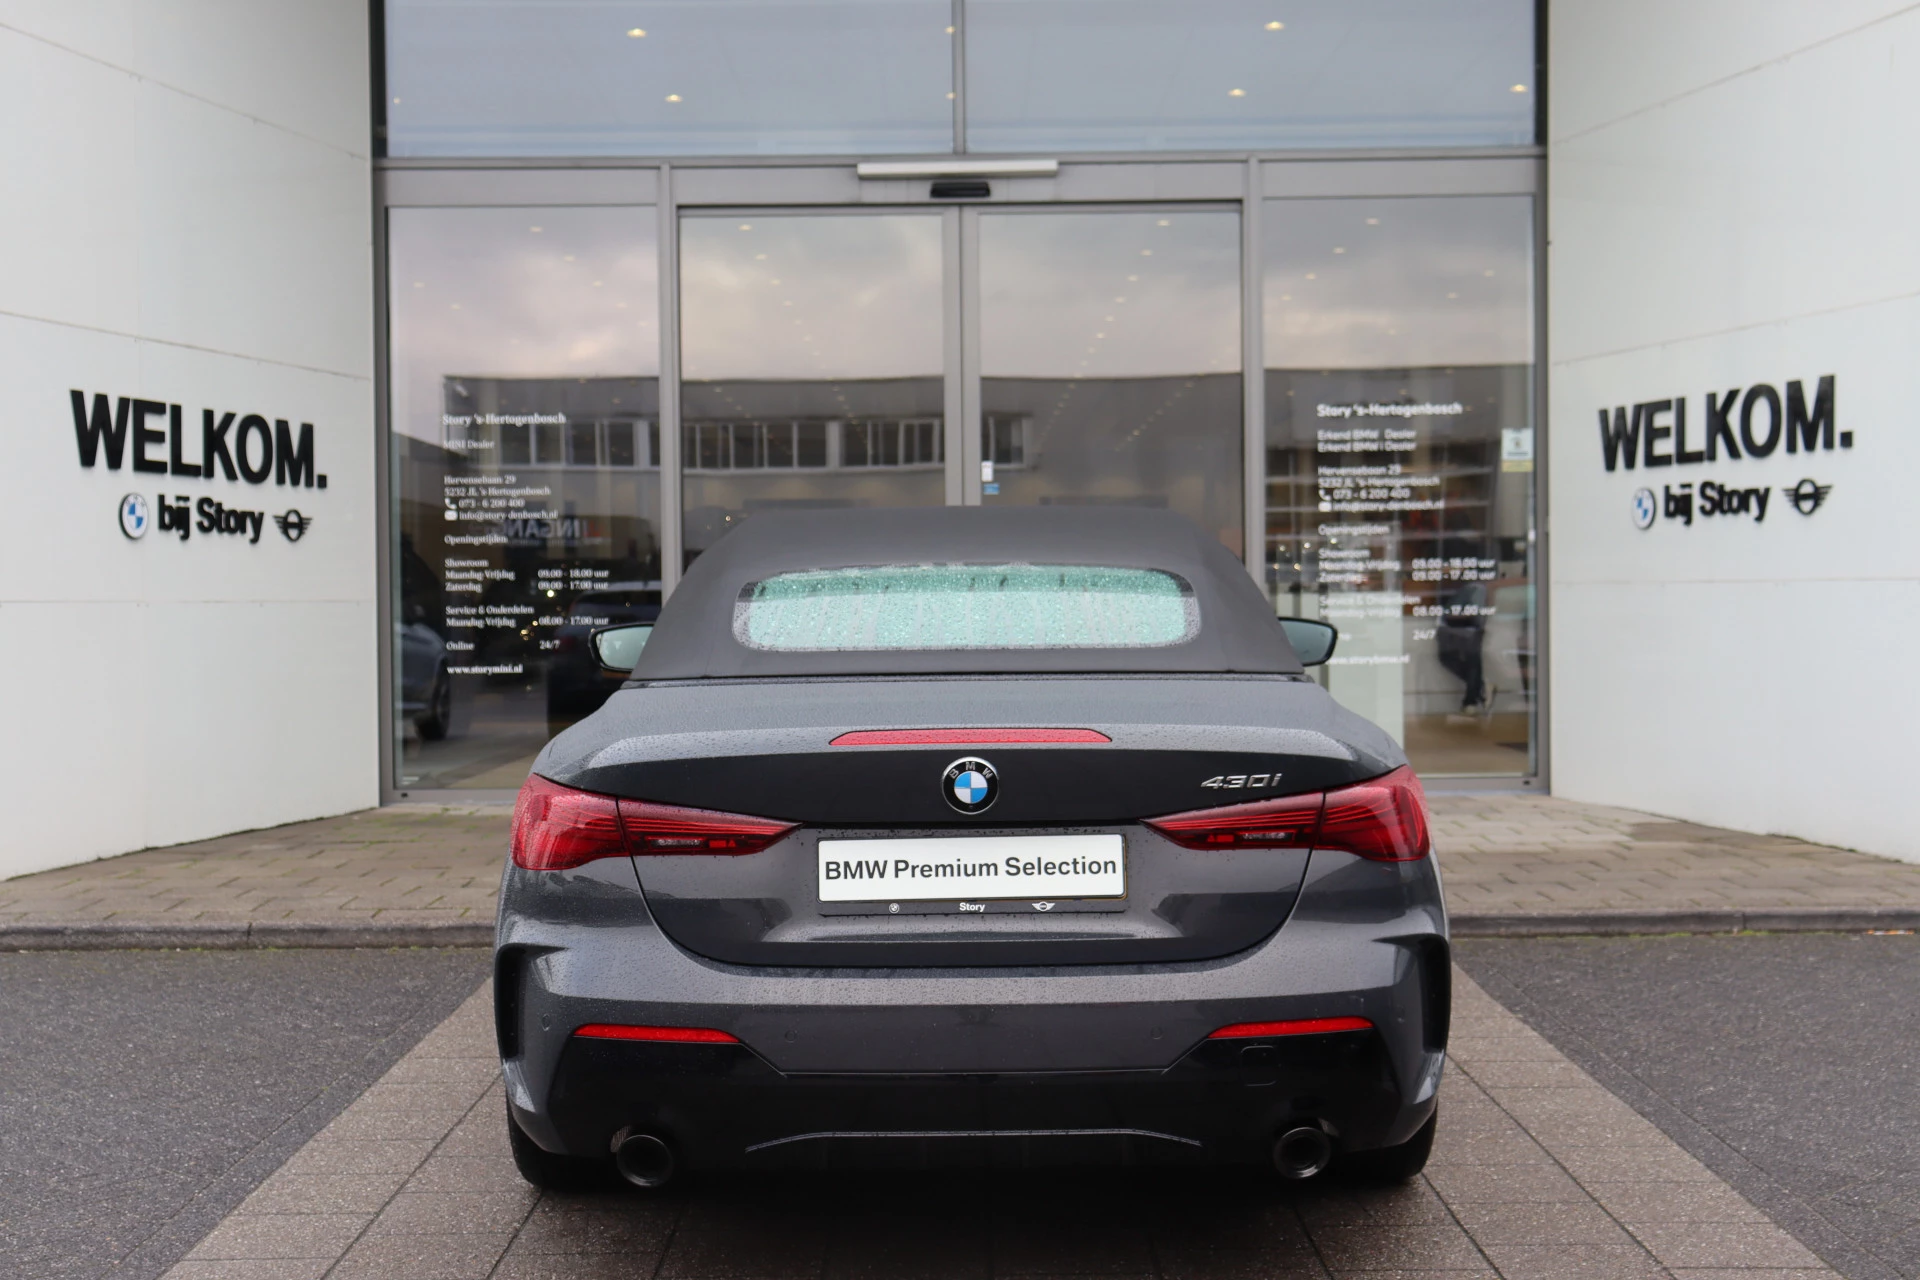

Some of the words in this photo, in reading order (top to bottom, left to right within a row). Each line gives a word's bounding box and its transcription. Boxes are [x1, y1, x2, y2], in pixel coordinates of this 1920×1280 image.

[1317, 403, 1352, 419] Story
[442, 413, 472, 428] Story
[1598, 374, 1853, 472] WELKOM.
[70, 389, 327, 489] WELKOM.
[1317, 429, 1351, 441] Erkend
[1353, 429, 1379, 439] BMW
[1384, 428, 1417, 439] Dealer
[443, 440, 466, 450] MINI
[467, 439, 495, 450] Dealer
[1317, 441, 1352, 452] Erkend
[1353, 441, 1379, 451] BMW
[1384, 440, 1417, 451] Dealer
[1388, 464, 1401, 475] 29
[504, 475, 516, 484] 29
[1333, 488, 1352, 499] 073
[1368, 488, 1389, 499] 200
[1390, 487, 1411, 499] 400
[458, 498, 476, 508] 073
[490, 498, 507, 508] 200
[508, 498, 525, 508] 400
[1664, 484, 1692, 526] bij
[1699, 481, 1771, 522] Story
[158, 494, 190, 541] bij
[196, 496, 264, 544] Story
[1318, 524, 1390, 537] Openingstijden
[444, 536, 508, 546] Openingstijden
[1318, 549, 1370, 559] Showroom
[444, 559, 489, 568] Showroom
[1478, 558, 1496, 568] uur
[593, 570, 609, 578] uur
[1318, 571, 1362, 584] Zaterdag
[1479, 571, 1496, 580] uur
[445, 582, 482, 593] Zaterdag
[593, 582, 609, 590] uur
[446, 606, 476, 615] Service
[478, 606, 485, 615] &
[485, 605, 535, 615] Onderdelen
[1479, 606, 1496, 615] uur
[593, 617, 609, 625] uur
[1412, 630, 1435, 640] 24/7
[446, 641, 475, 651] Online
[539, 640, 560, 649] 24/7
[447, 663, 523, 674] www.storymini.nl
[948, 761, 994, 780] BMW
[1200, 773, 1282, 789] 430i
[825, 860, 888, 880] BMW
[894, 858, 999, 879] Premium
[1004, 855, 1117, 876] Selection
[959, 902, 985, 912] Story
